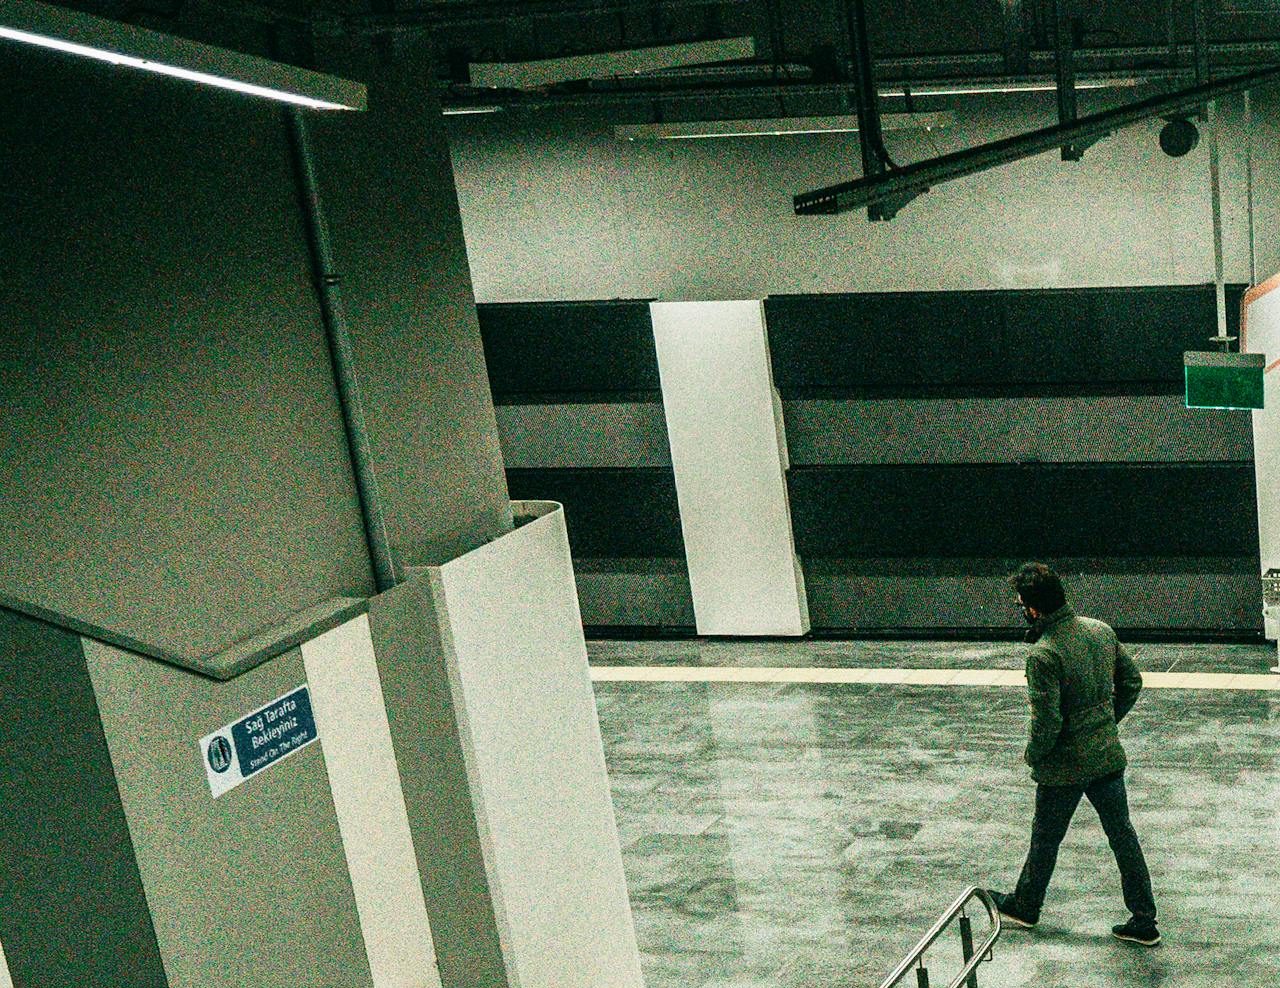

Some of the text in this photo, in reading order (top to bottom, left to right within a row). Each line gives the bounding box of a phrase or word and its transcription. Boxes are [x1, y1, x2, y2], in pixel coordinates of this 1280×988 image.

[245, 700, 297, 734] Sağ Tarafta
[252, 716, 298, 749] Bekleyiniz
